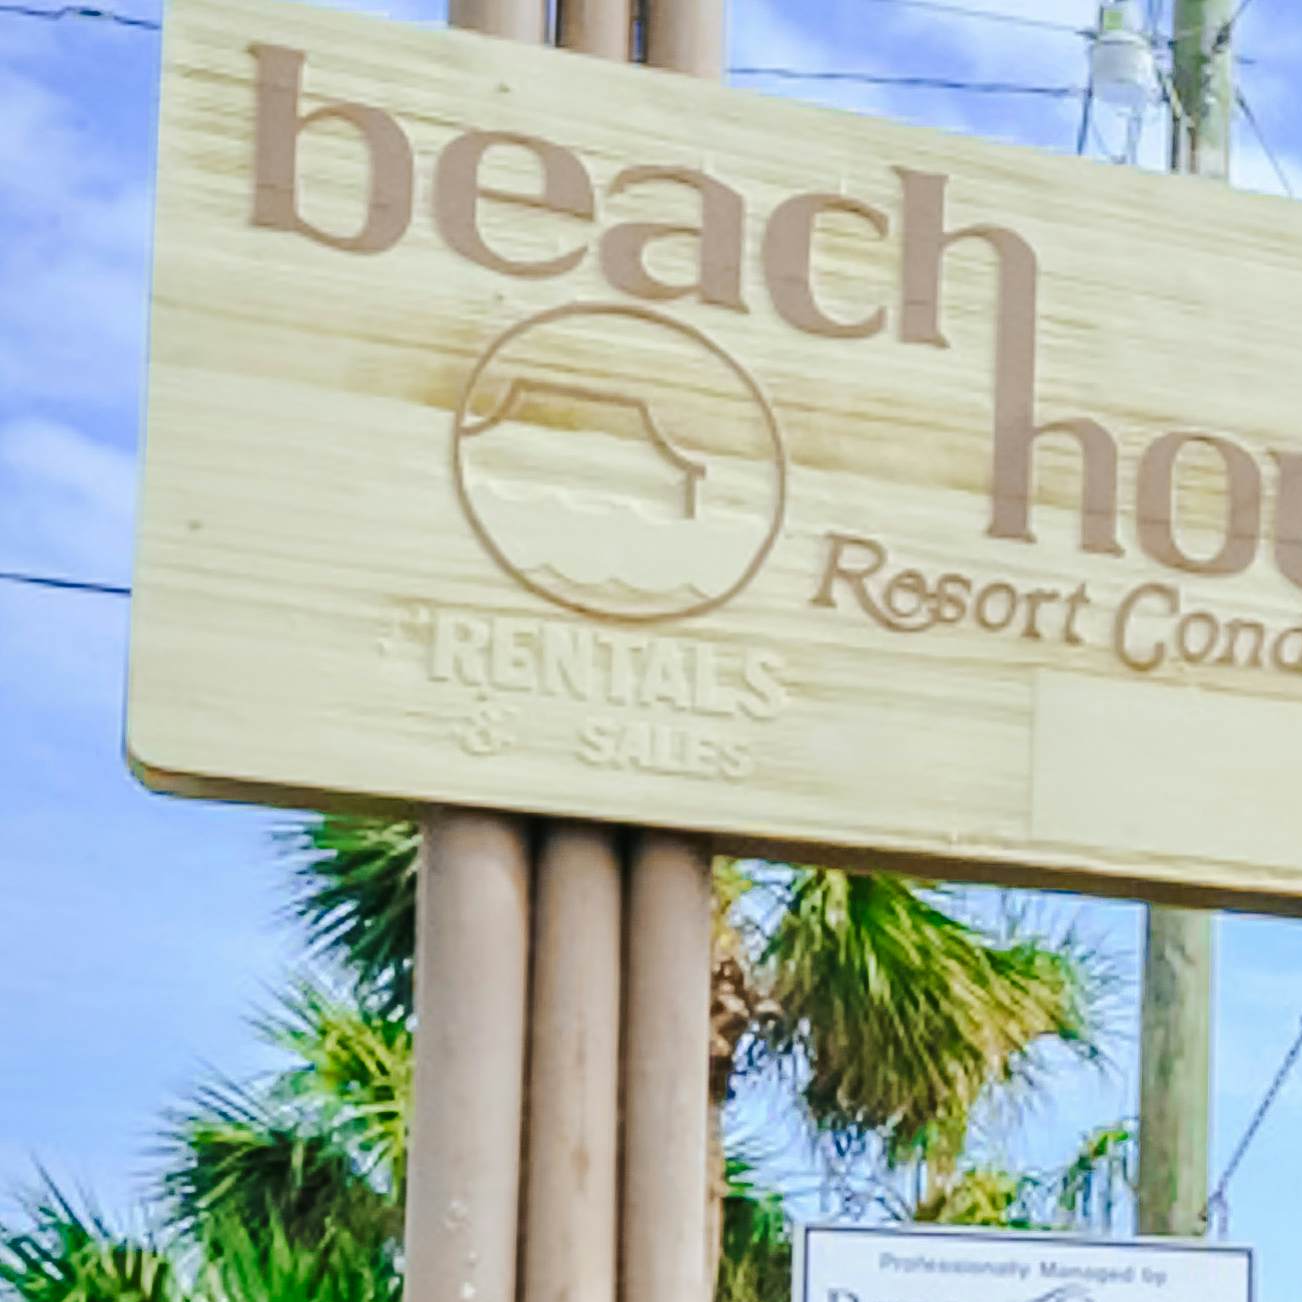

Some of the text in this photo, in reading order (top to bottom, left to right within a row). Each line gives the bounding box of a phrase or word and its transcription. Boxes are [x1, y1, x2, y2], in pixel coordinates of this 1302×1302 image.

[247, 43, 1037, 349] beach
[814, 531, 1089, 648] Resort
[428, 612, 792, 722] RENTALS
[576, 714, 755, 787] SALES
[879, 1251, 1168, 1287] Professionally Managed by
